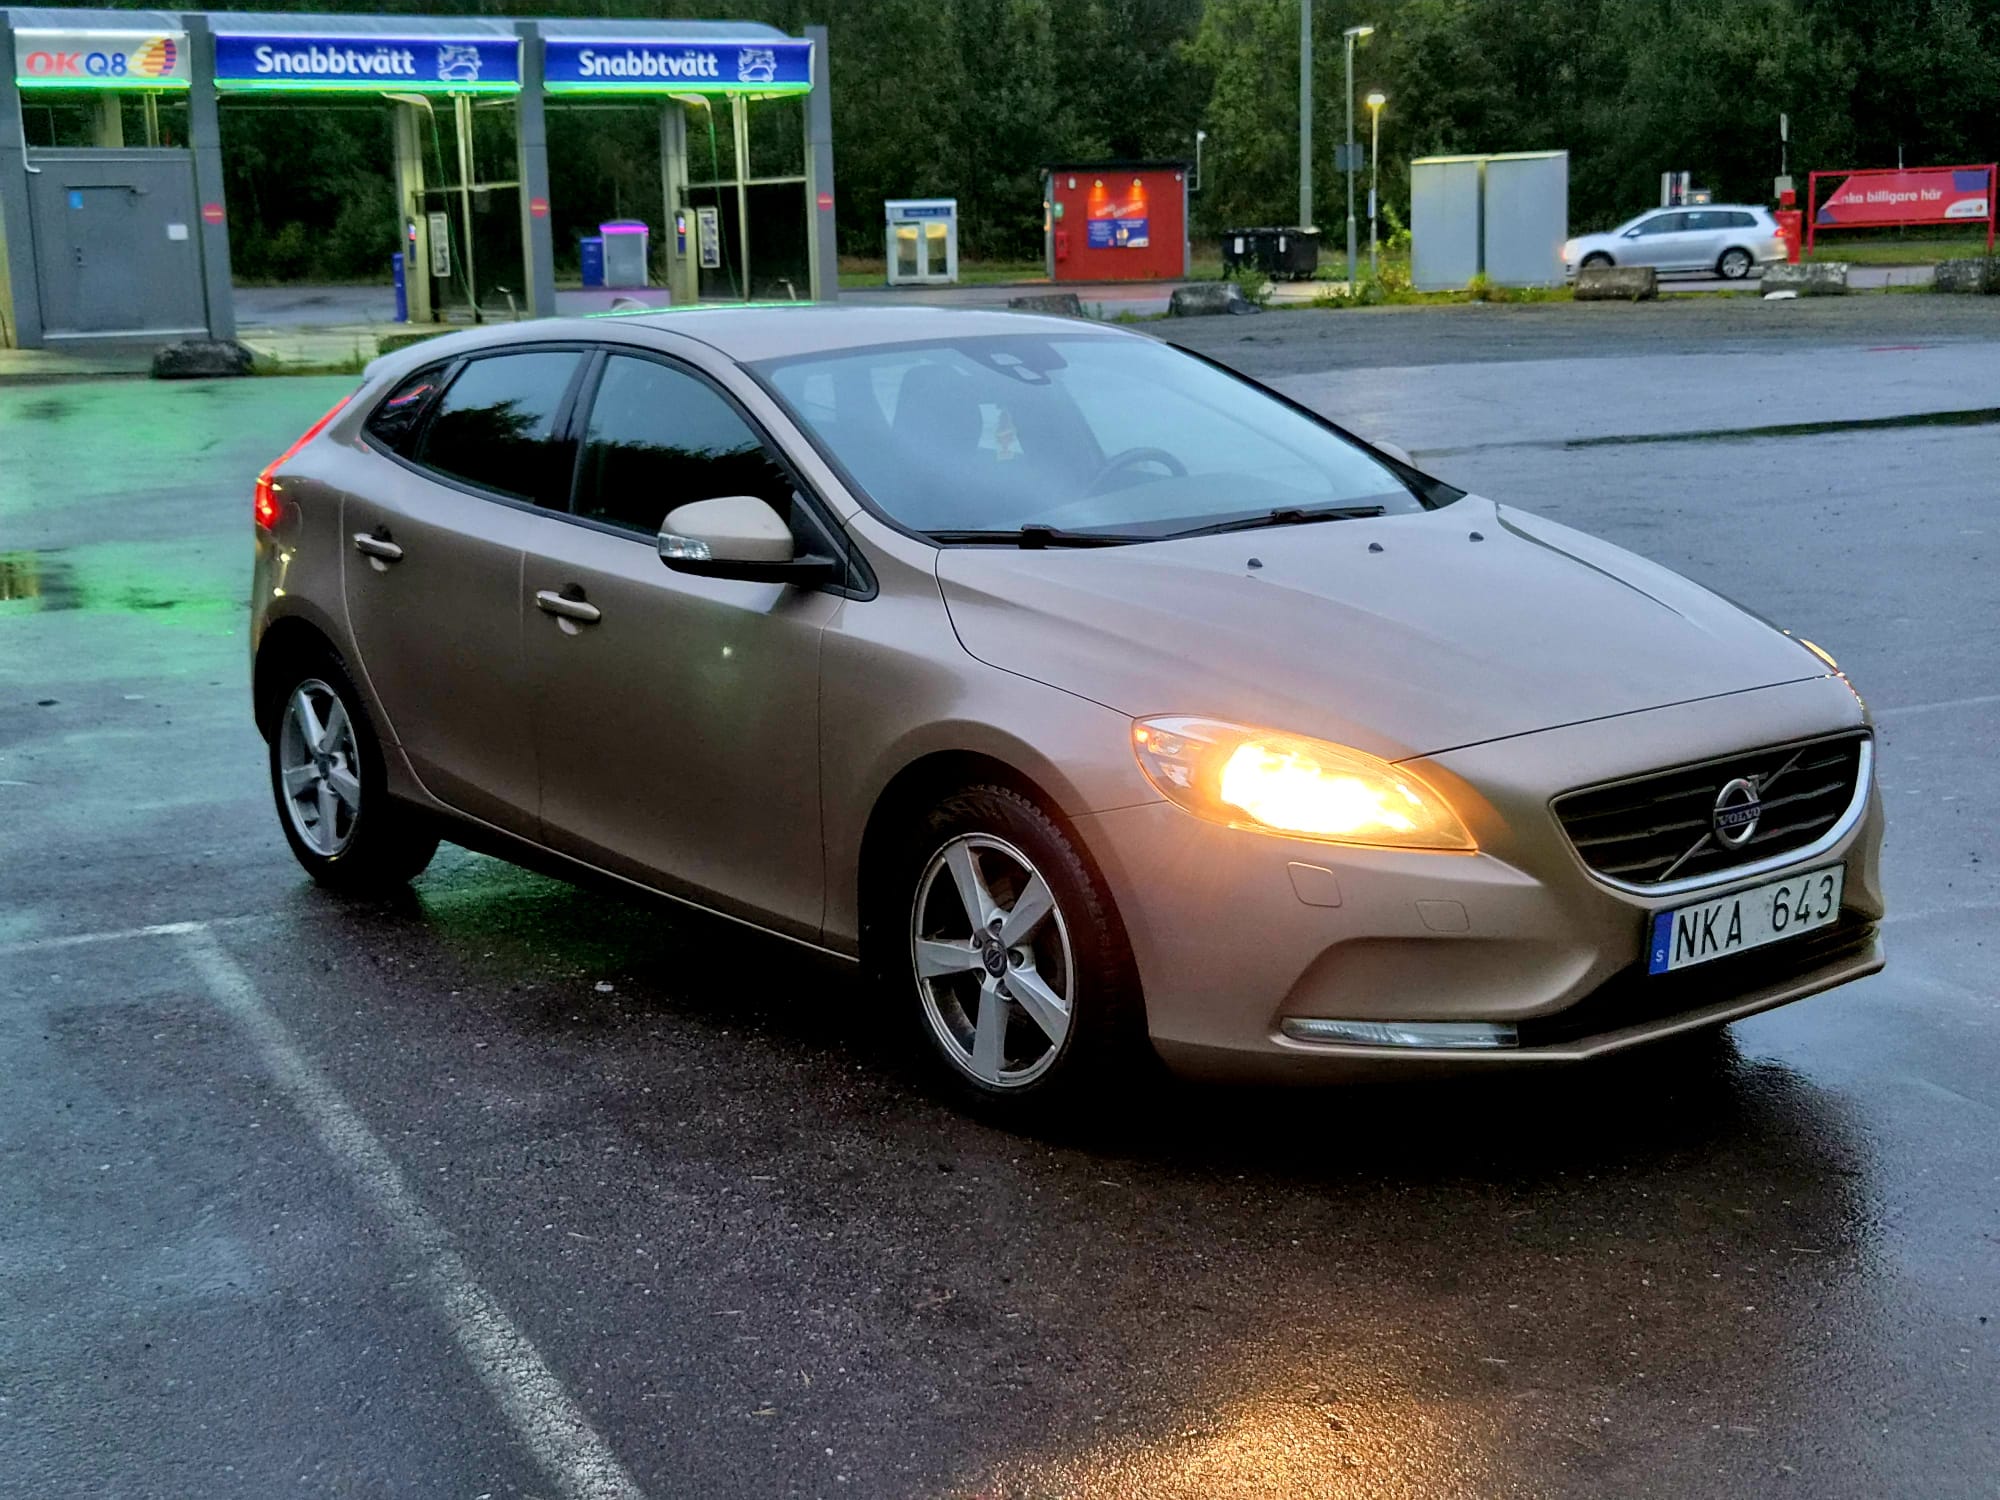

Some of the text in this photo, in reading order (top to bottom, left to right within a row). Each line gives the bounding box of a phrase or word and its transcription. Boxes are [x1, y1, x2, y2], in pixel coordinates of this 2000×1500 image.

[255, 45, 416, 75] Snabbtvätt
[578, 49, 719, 77] Snabbtvätt
[1867, 189, 1918, 205] billigare
[1921, 188, 1942, 201] här
[1718, 806, 1760, 826] VOLVO
[1676, 900, 1743, 962] NKA
[1772, 875, 1834, 932] 643
